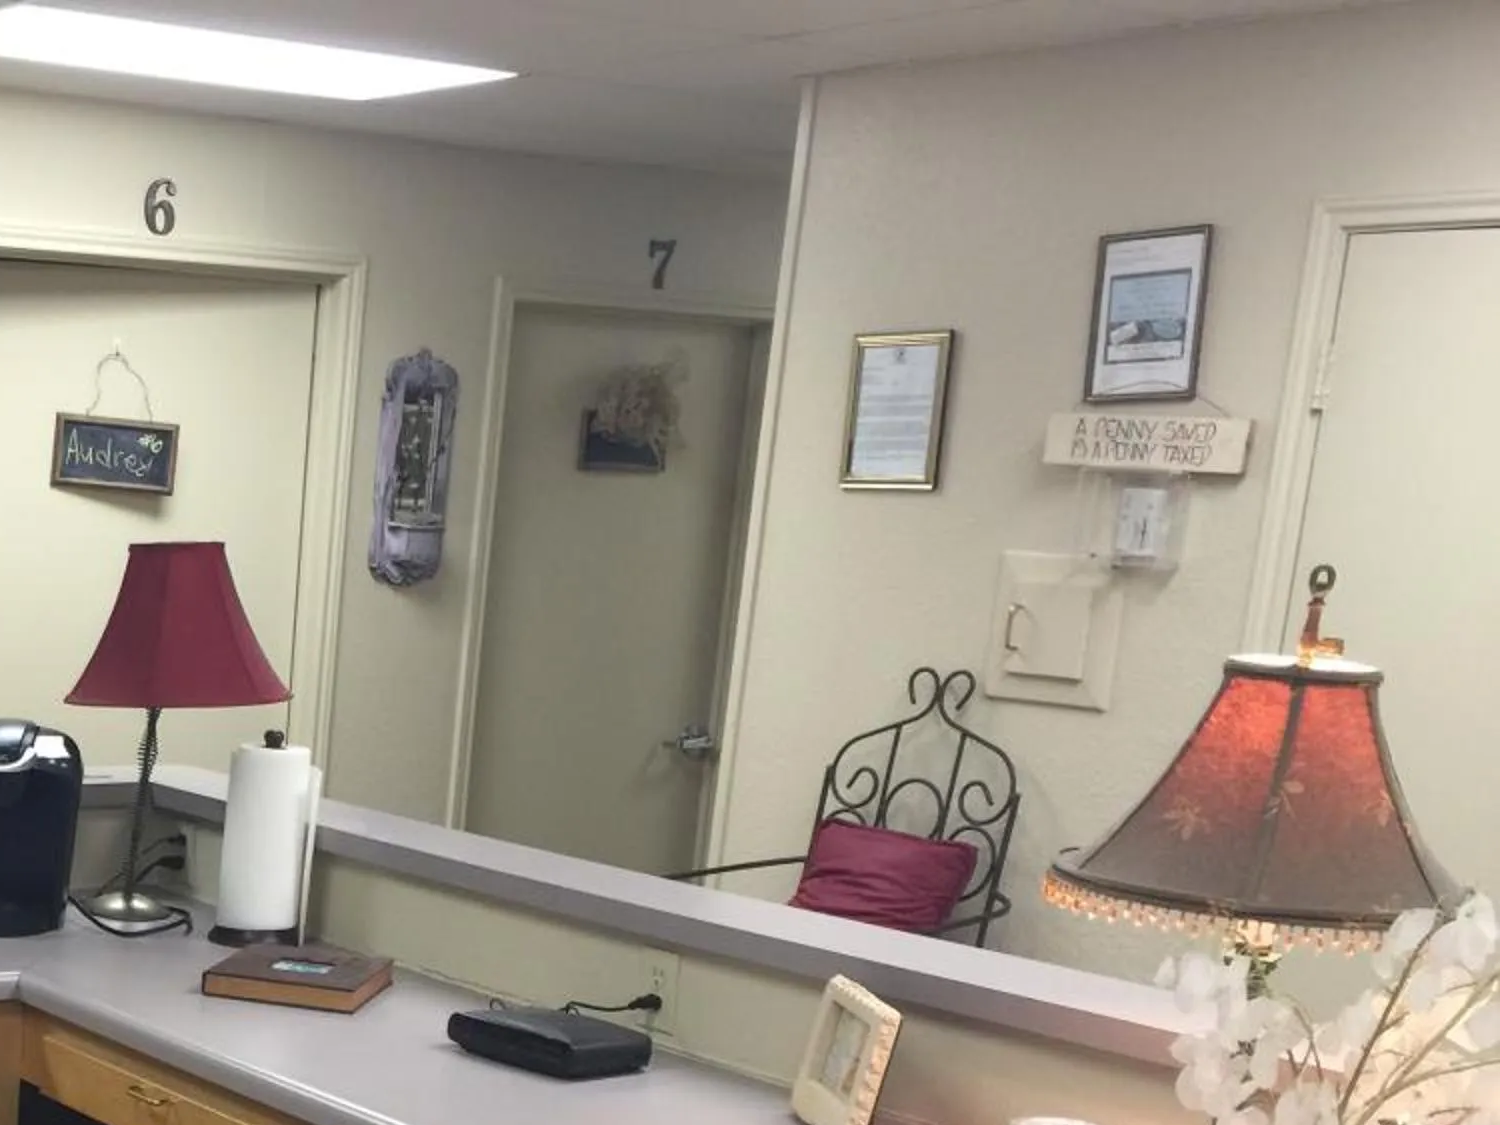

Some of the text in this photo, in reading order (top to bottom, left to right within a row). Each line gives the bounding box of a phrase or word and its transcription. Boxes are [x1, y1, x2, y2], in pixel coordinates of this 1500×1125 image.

[143, 178, 177, 236] 6
[648, 238, 678, 291] 7
[64, 427, 153, 478] Audrey
[1075, 417, 1088, 436] A
[1094, 416, 1160, 441] PENNY
